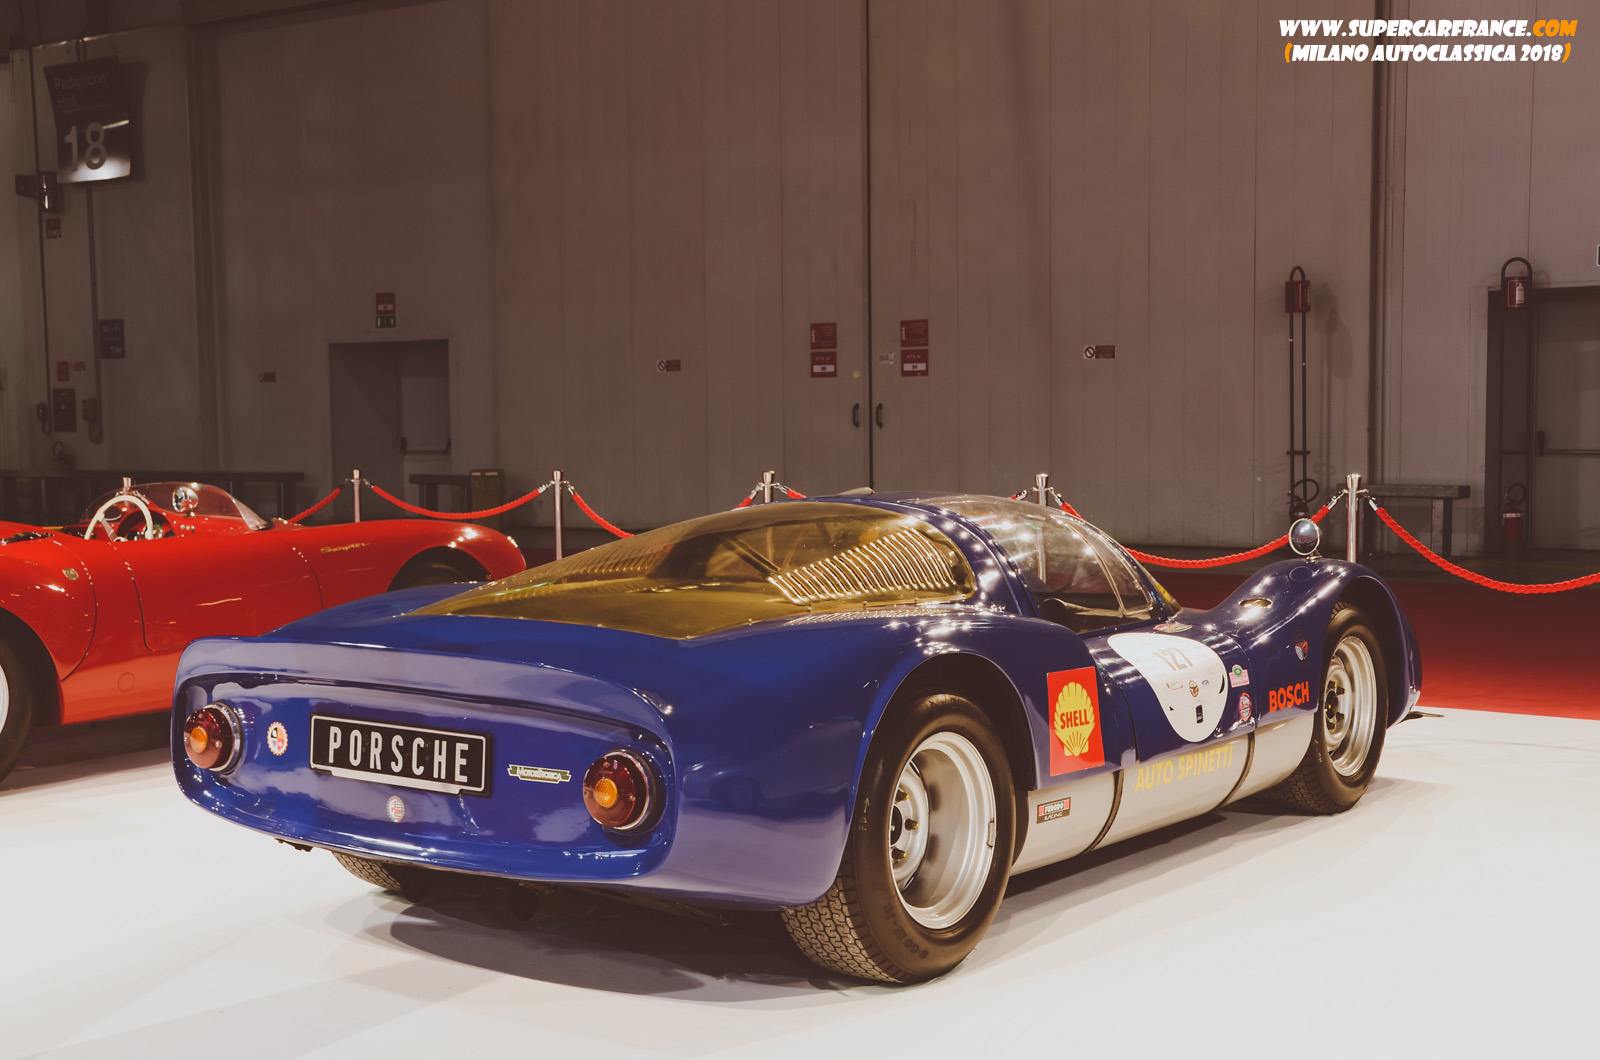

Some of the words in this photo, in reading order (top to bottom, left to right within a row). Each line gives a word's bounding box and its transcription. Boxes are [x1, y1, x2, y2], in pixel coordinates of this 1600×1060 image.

[54, 72, 107, 91] Padiglione
[64, 121, 108, 173] 18
[1152, 647, 1194, 671] 127
[1268, 681, 1310, 713] BOSCH
[1059, 709, 1090, 730] SHELL
[328, 726, 469, 783] PORSCHE
[1134, 760, 1174, 793] AUTO
[1177, 744, 1234, 781] SPINETTI
